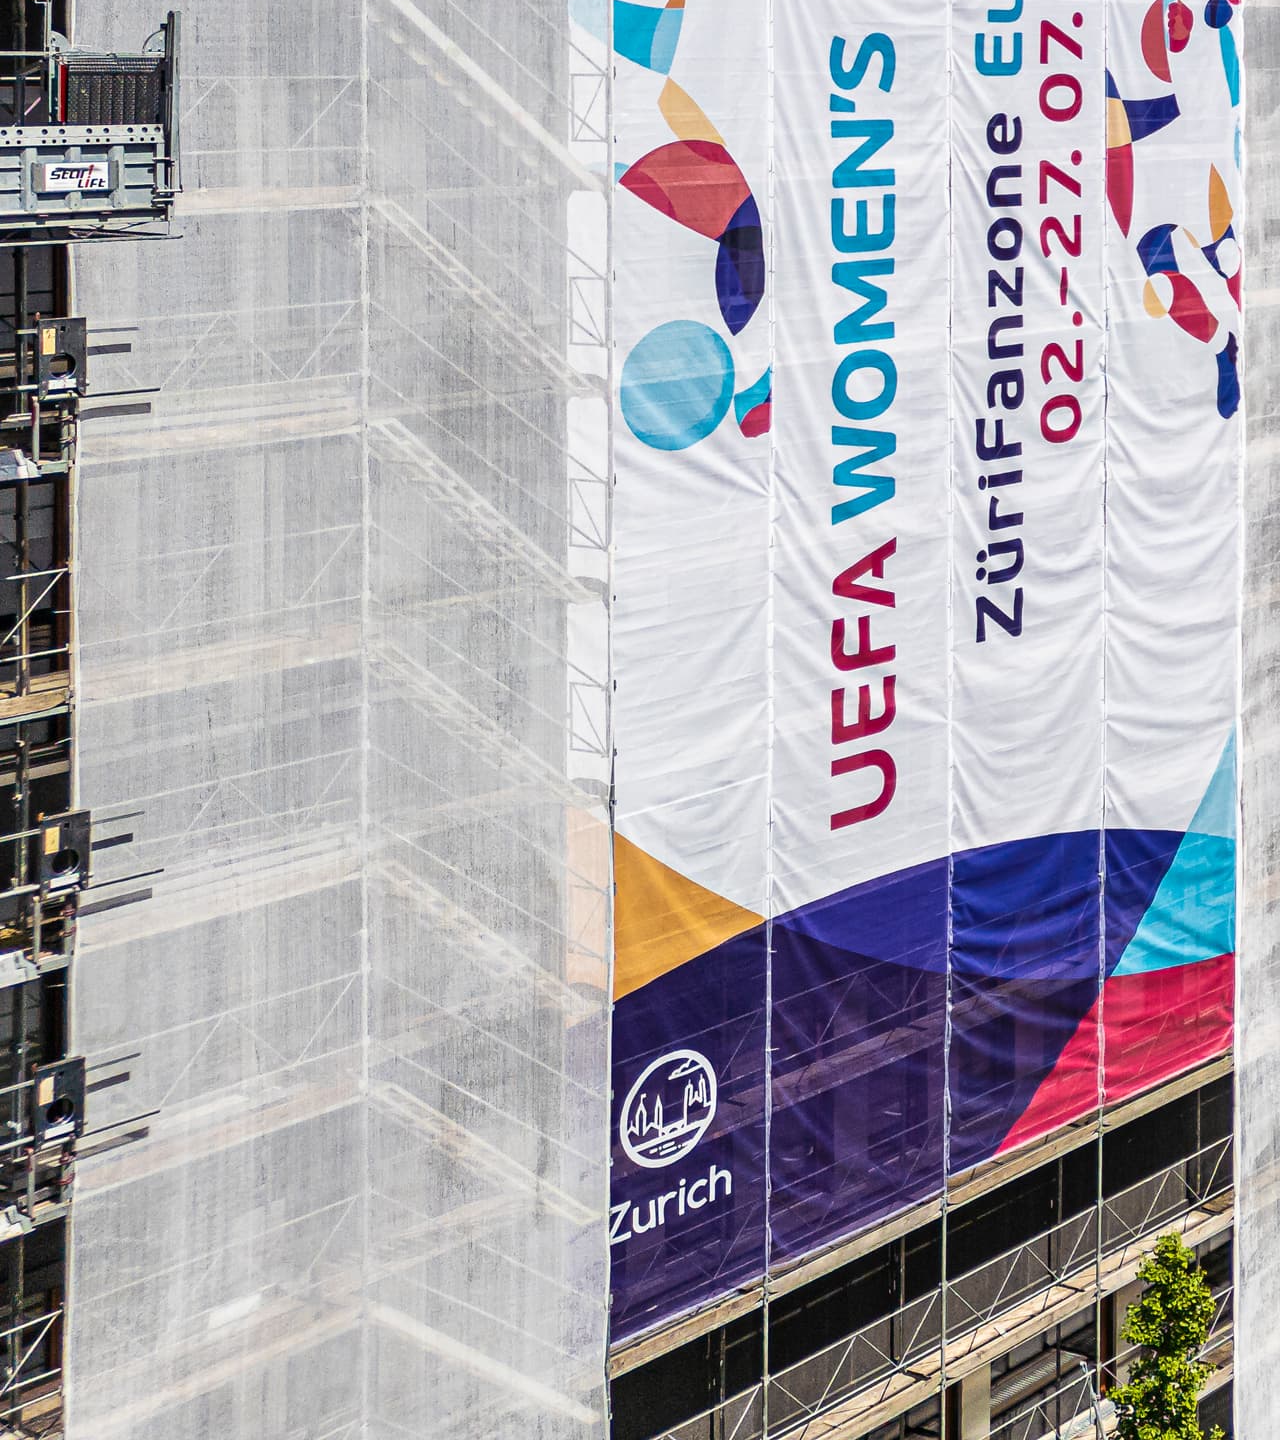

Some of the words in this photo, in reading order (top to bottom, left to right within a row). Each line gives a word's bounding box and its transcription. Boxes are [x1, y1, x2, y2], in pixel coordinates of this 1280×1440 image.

[1039, 12, 1083, 122] 07.
[829, 32, 898, 526] WOMEN'S
[975, 112, 1024, 643] ZüriFanzone
[831, 537, 897, 830] UEFA
[610, 1164, 732, 1246] Zurich
